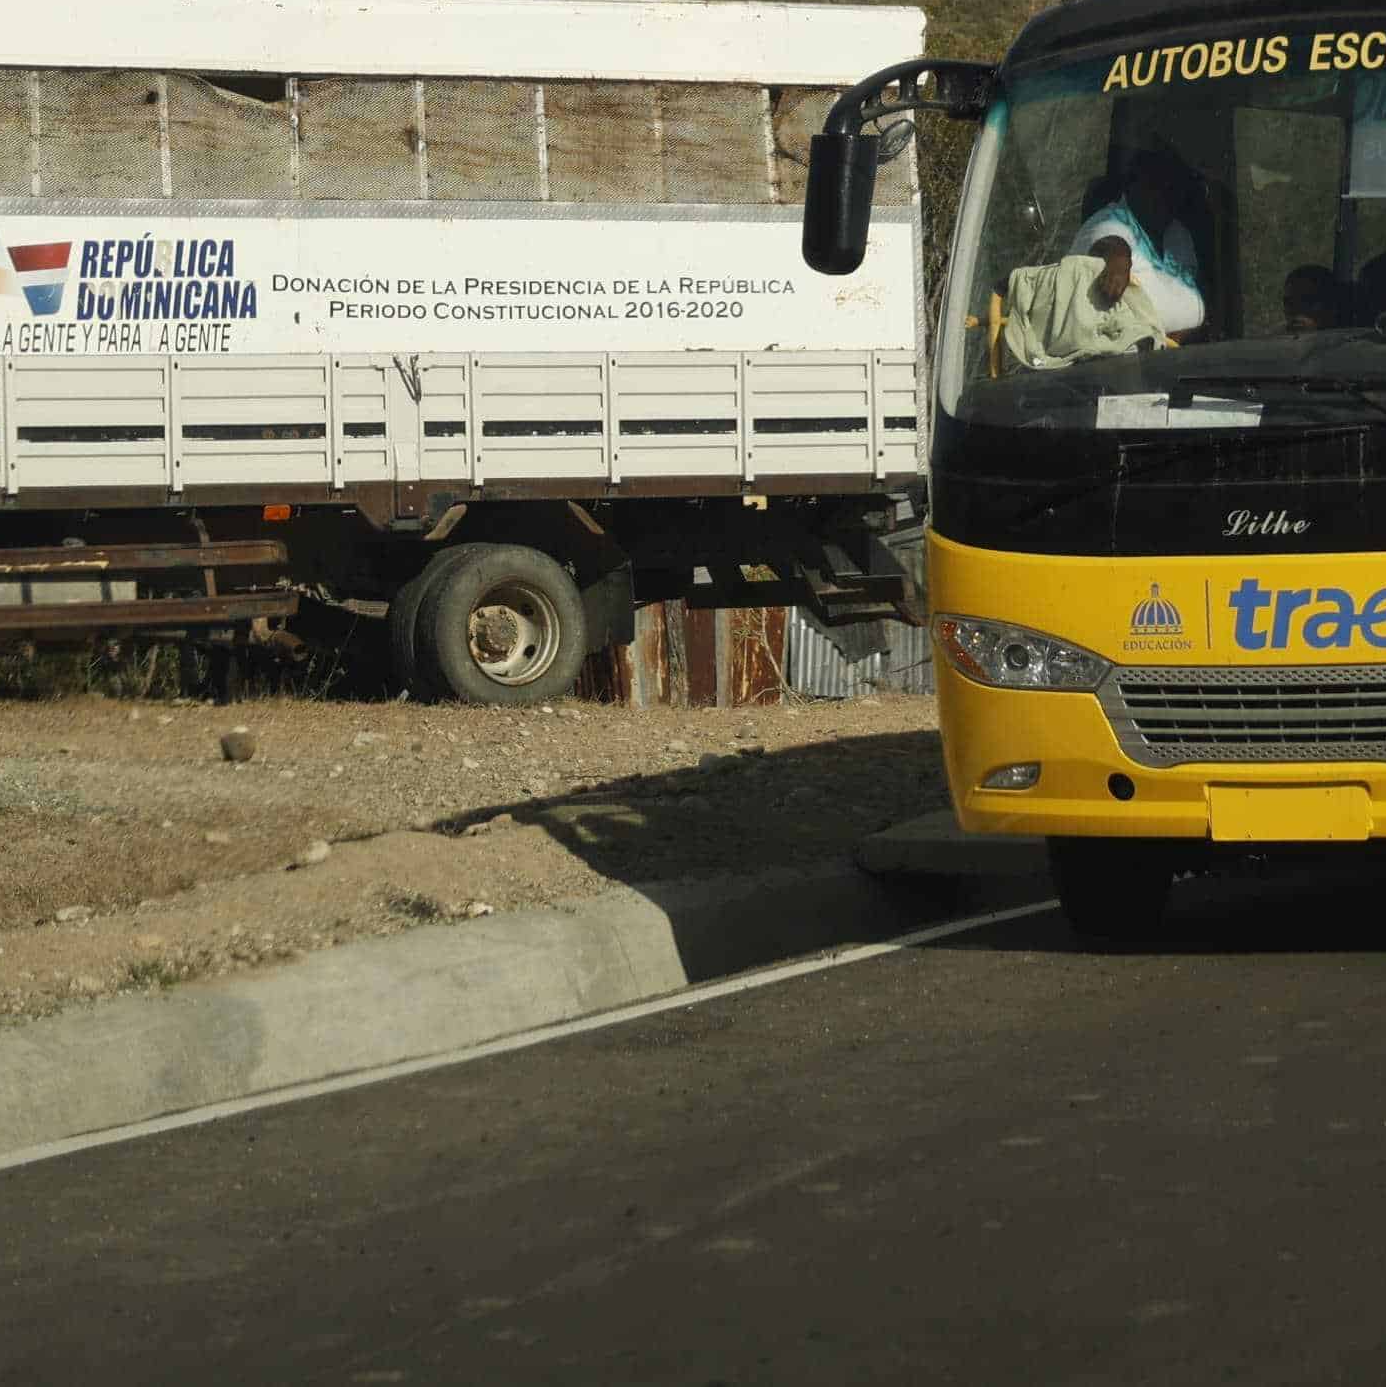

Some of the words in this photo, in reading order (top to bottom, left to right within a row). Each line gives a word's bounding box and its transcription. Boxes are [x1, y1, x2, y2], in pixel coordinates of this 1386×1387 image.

[1103, 35, 1289, 92] AUTOBUS
[77, 280, 257, 321] DOMINICANA
[625, 301, 743, 318] 2016-2020
[19, 323, 76, 352] GENTE
[83, 324, 95, 352] Y
[98, 324, 142, 352] PARA
[175, 323, 231, 352] GENTE
[1222, 510, 1311, 536] Lithe
[1123, 637, 1192, 650] EDUCACIÓN
